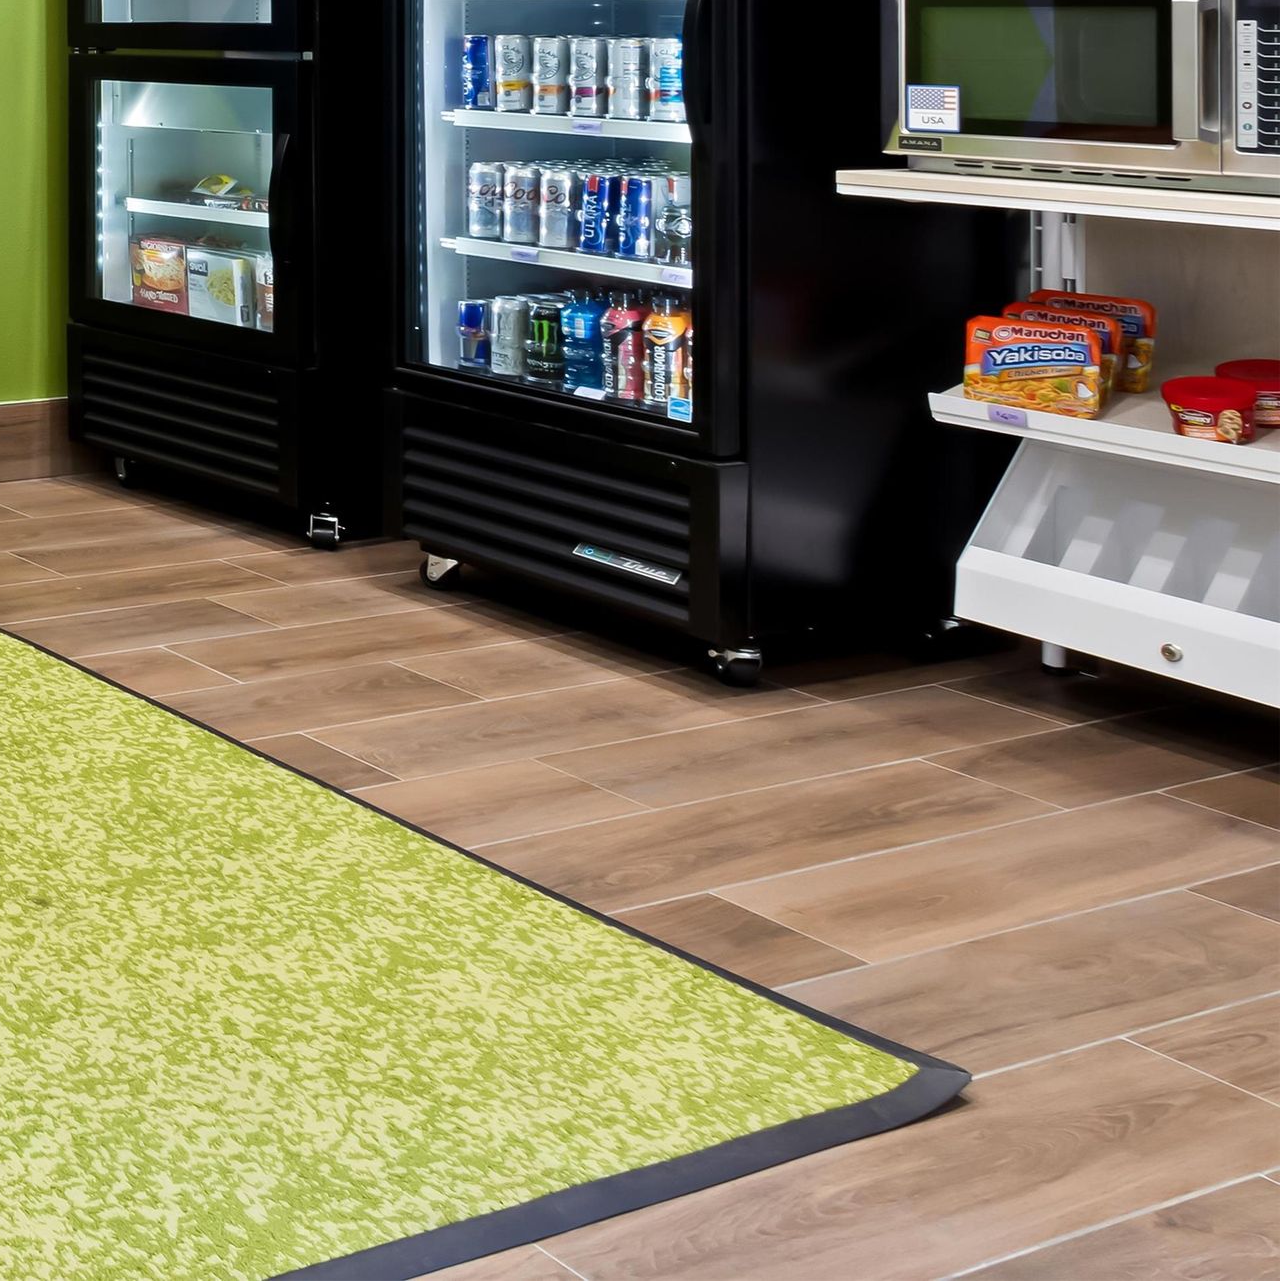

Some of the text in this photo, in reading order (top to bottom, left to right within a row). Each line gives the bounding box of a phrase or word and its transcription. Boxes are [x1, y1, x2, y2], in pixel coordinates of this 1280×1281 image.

[921, 115, 945, 125] USA
[901, 139, 939, 147] AMANA
[1062, 298, 1138, 315] Maruchan
[1035, 311, 1107, 330] Maruchan
[1011, 326, 1087, 343] Maruchan
[989, 346, 1086, 366] Yakisoba
[1006, 367, 1049, 379] Chicken
